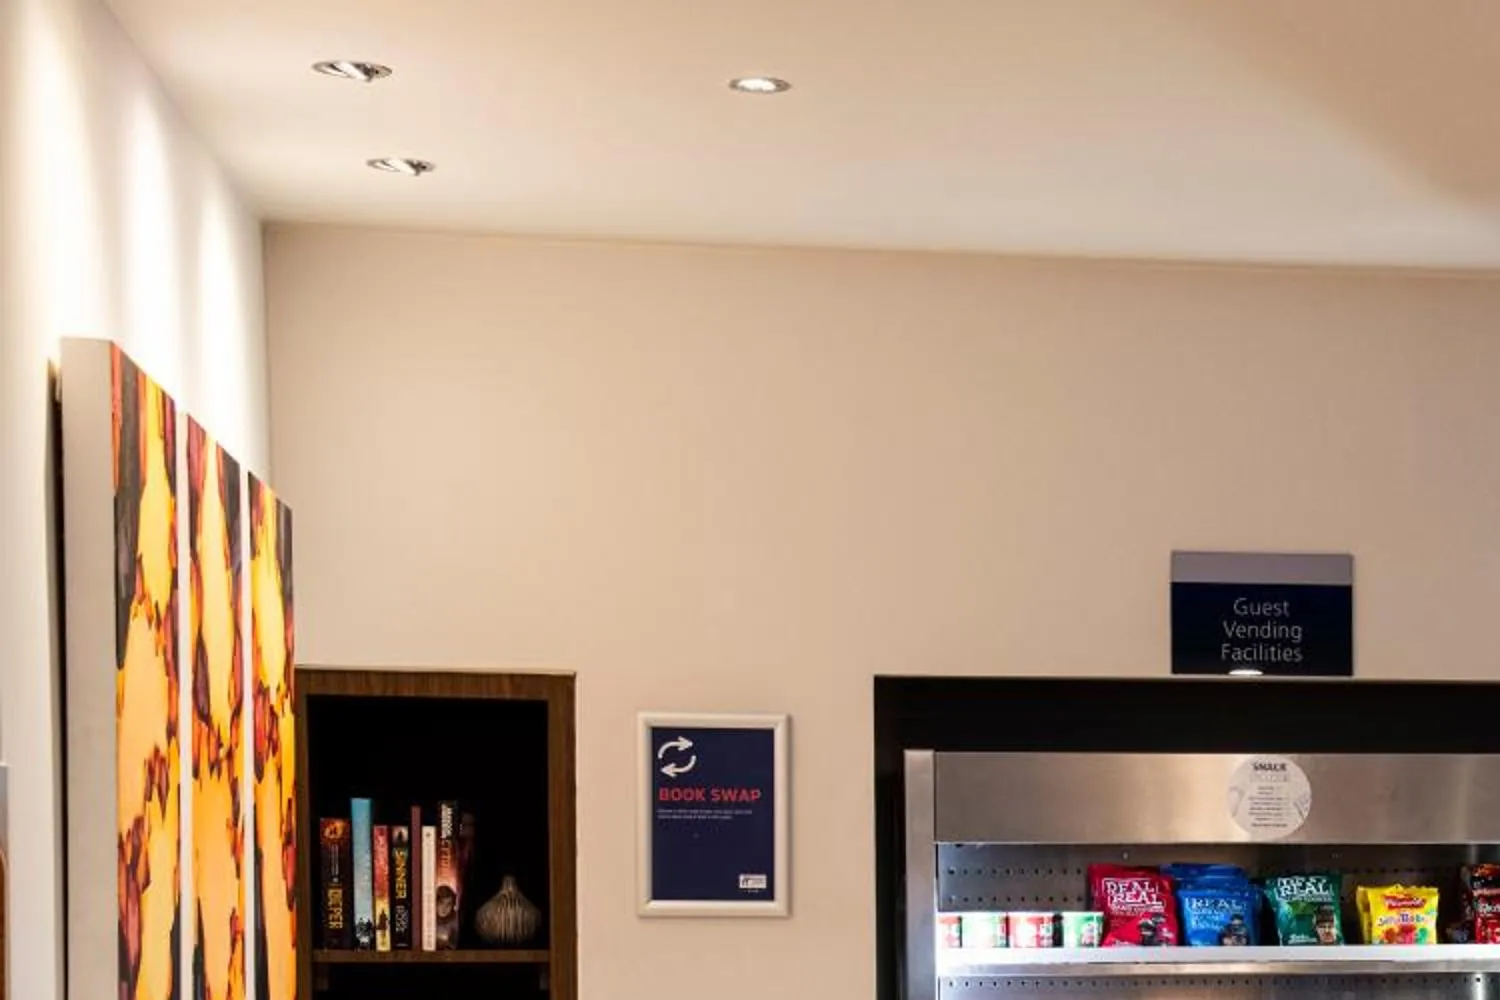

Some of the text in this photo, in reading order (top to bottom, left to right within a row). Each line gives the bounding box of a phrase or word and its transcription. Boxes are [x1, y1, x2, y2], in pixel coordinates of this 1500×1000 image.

[1233, 597, 1290, 617] Guest
[1222, 619, 1303, 643] Vending
[1221, 642, 1303, 662] Facilities
[658, 787, 762, 802] BOOK SWAP
